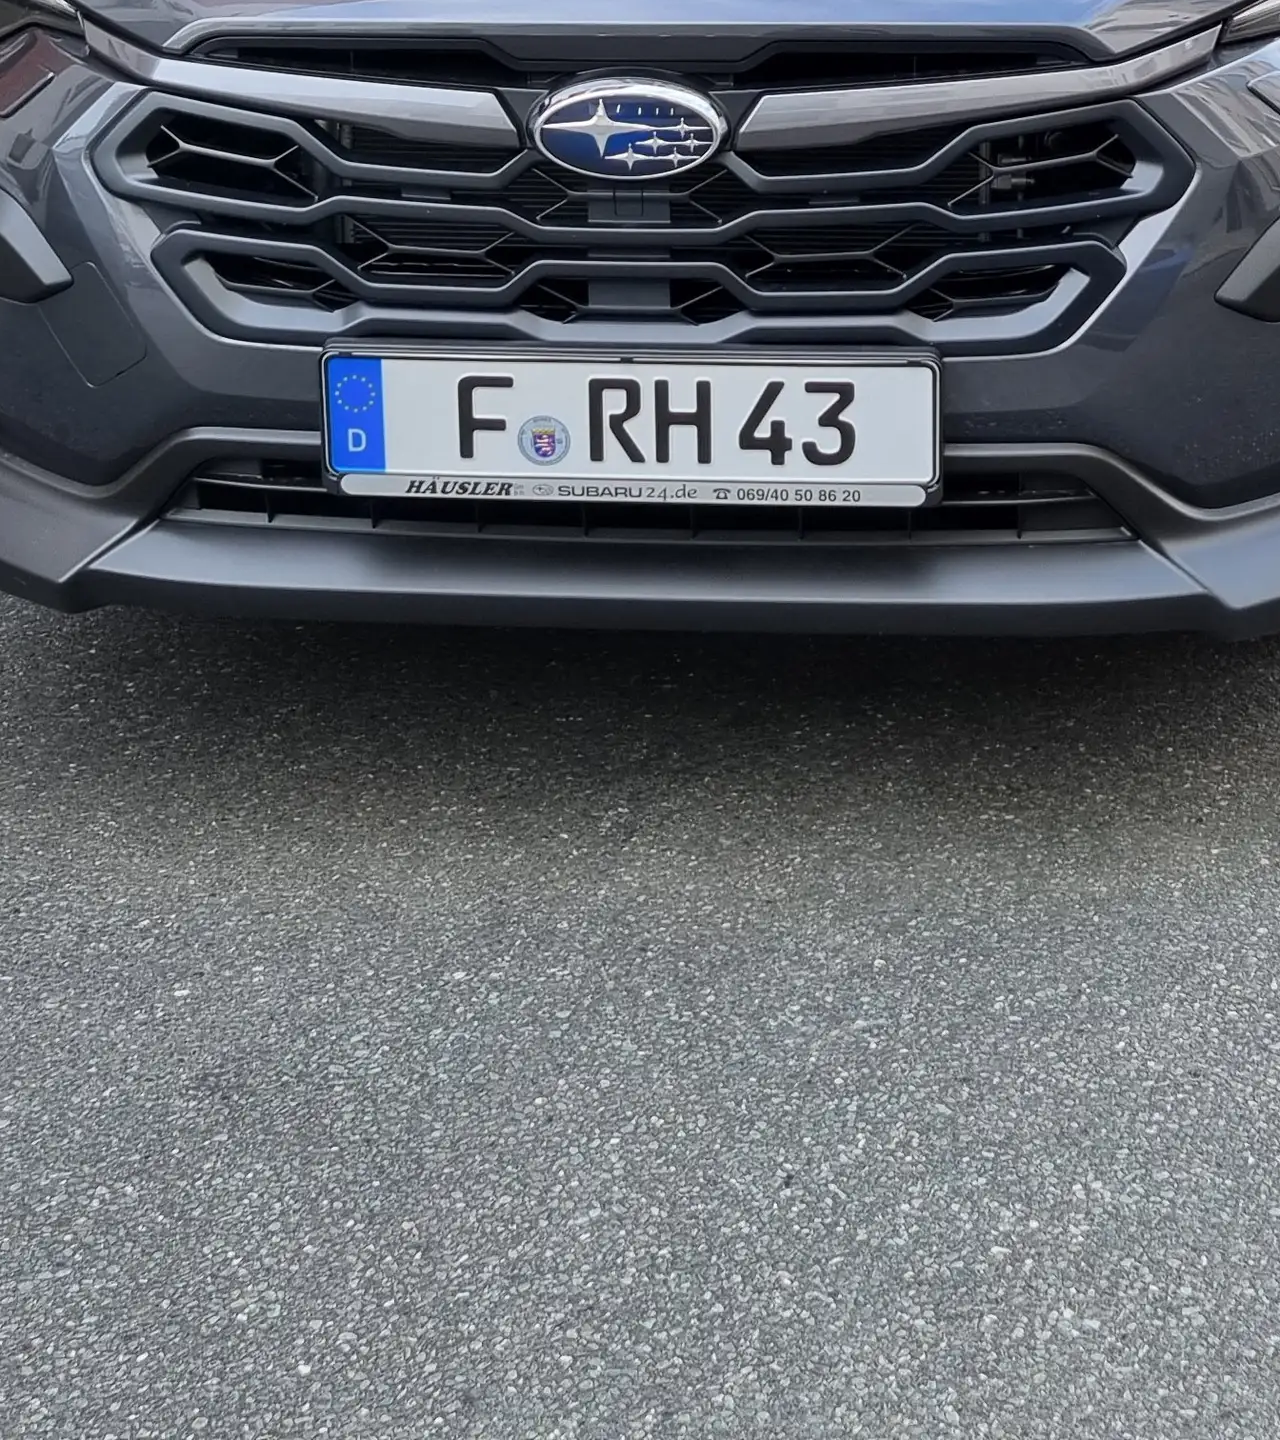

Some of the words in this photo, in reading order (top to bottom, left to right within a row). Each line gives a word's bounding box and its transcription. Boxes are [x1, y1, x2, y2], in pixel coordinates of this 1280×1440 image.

[457, 375, 514, 459] F
[588, 376, 712, 464] RH
[738, 380, 856, 466] 43
[347, 427, 367, 453] D
[404, 476, 513, 497] HÄUSLER
[736, 488, 790, 502] 069/40
[794, 489, 813, 502] 50
[818, 489, 837, 503] 86
[842, 490, 861, 503] 20
